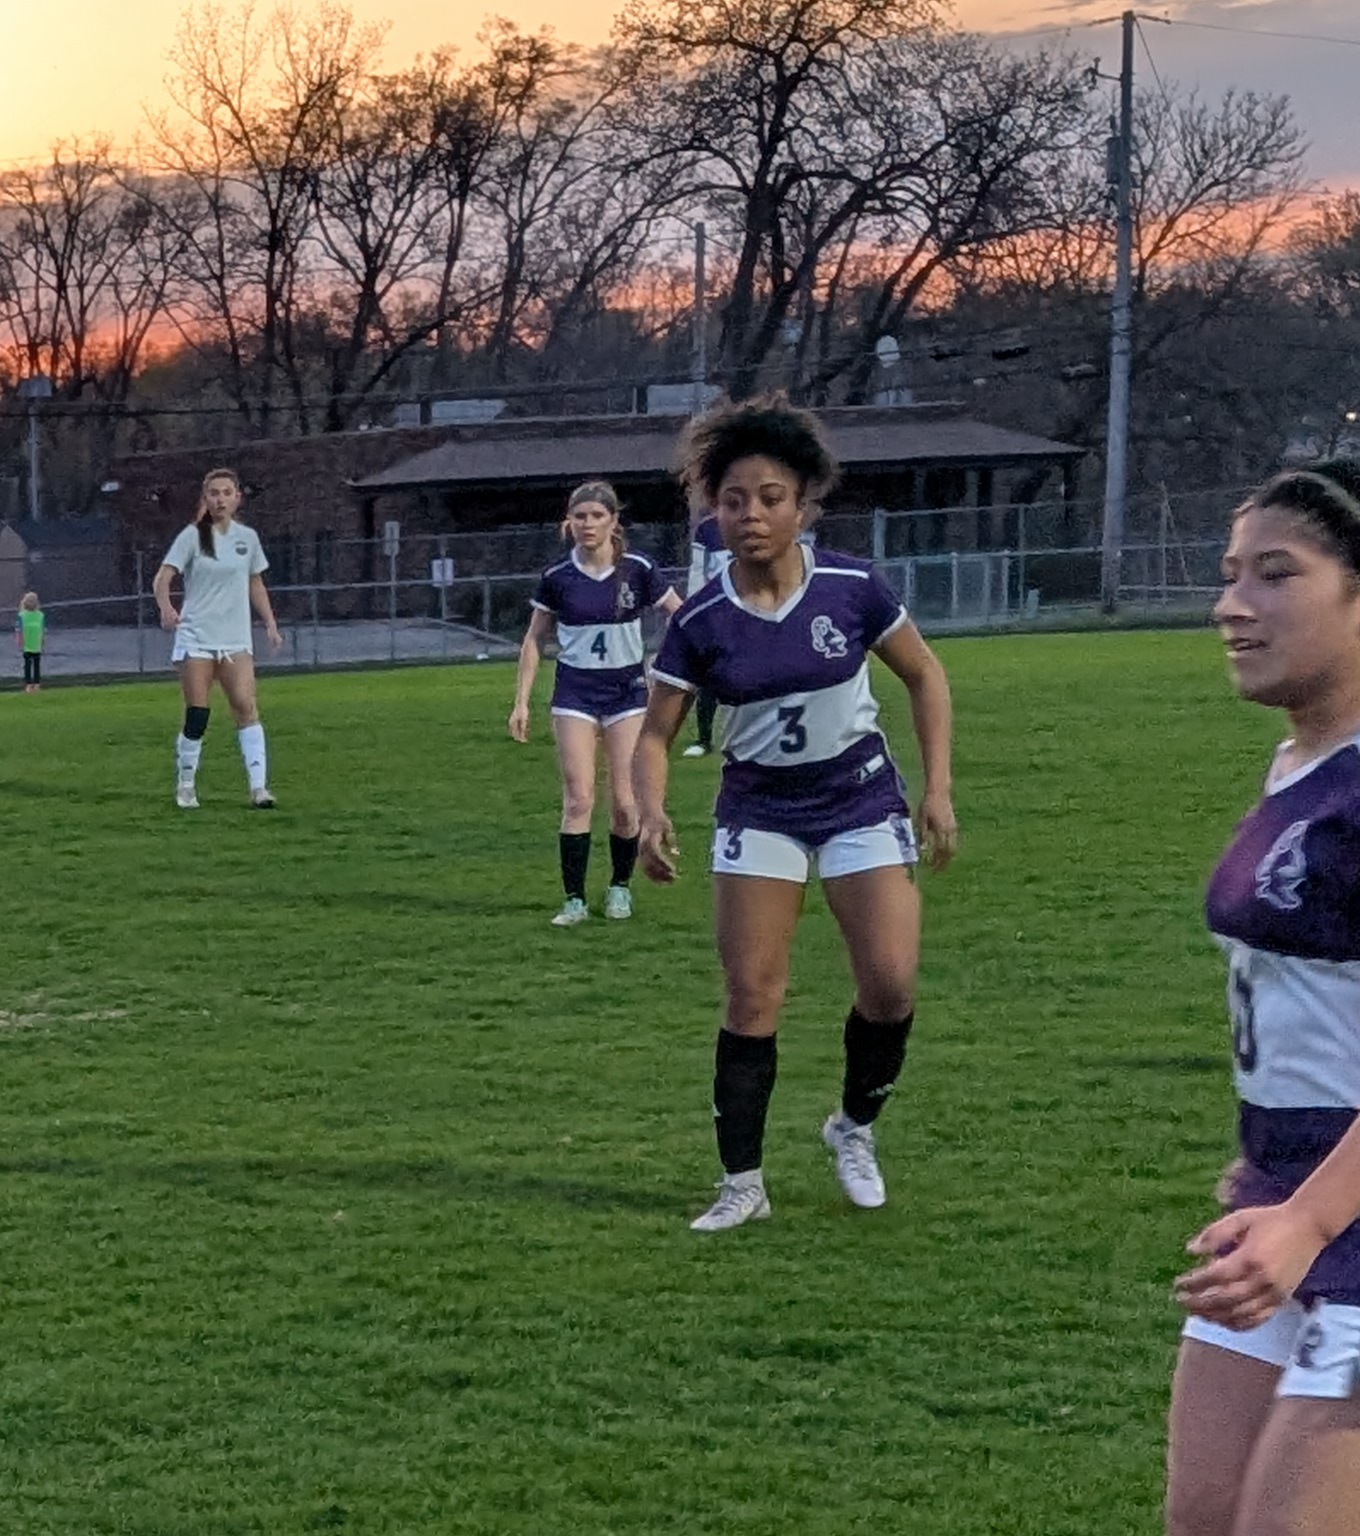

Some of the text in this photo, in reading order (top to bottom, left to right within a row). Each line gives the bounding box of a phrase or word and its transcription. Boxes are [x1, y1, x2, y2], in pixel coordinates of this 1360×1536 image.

[590, 631, 607, 661] 4
[778, 706, 807, 753] 3
[724, 825, 743, 860] 3
